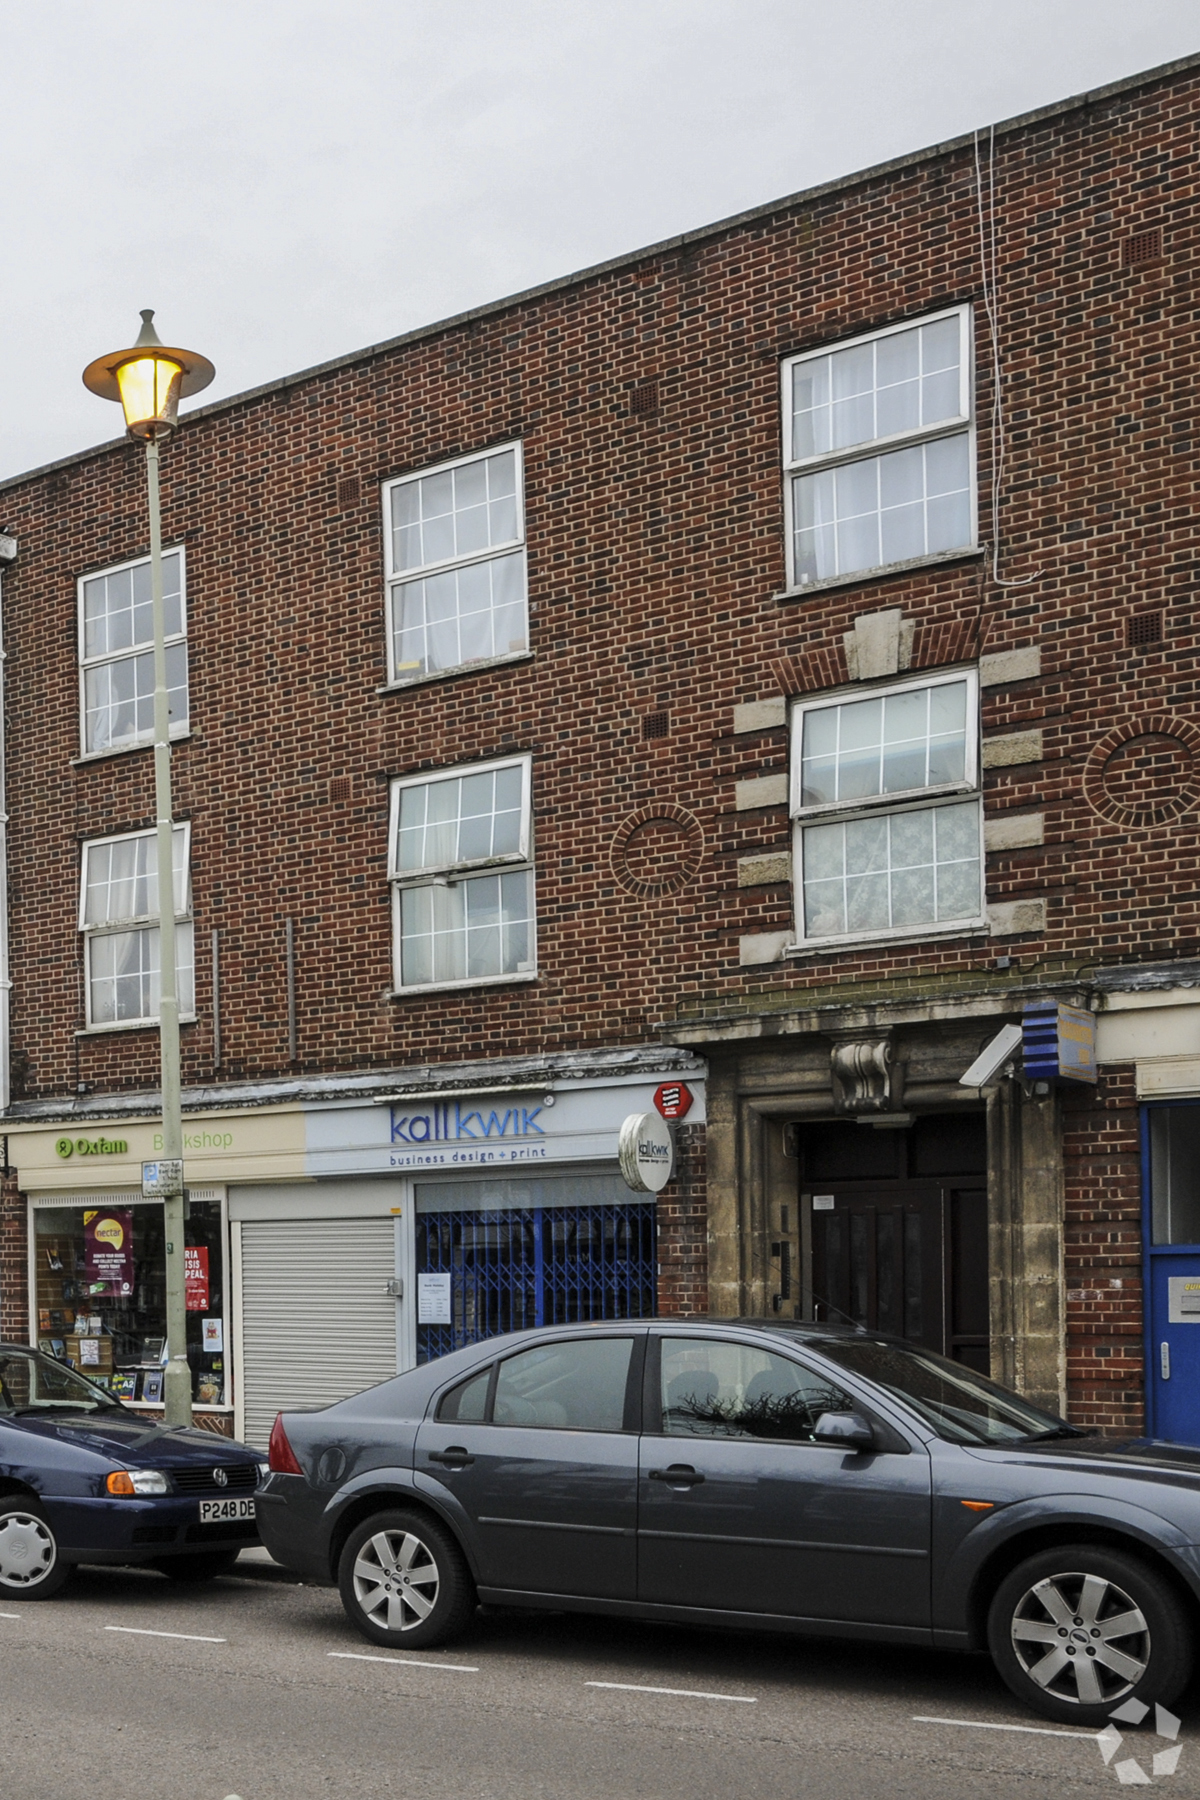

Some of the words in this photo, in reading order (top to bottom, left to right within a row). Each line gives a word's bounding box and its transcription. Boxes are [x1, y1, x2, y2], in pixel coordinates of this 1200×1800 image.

[74, 1137, 128, 1155] Oxfam
[153, 1131, 233, 1151] Bkshop
[390, 1155, 445, 1165] business
[452, 1151, 494, 1163] design
[511, 1147, 546, 1160] print
[147, 1167, 156, 1180] P
[96, 1229, 121, 1238] nectar
[185, 1250, 199, 1259] RIA
[185, 1260, 200, 1269] ISIS
[185, 1270, 204, 1279] PEAL
[122, 1379, 134, 1389] A2
[203, 1502, 237, 1519] P248
[240, 1500, 255, 1517] DE
